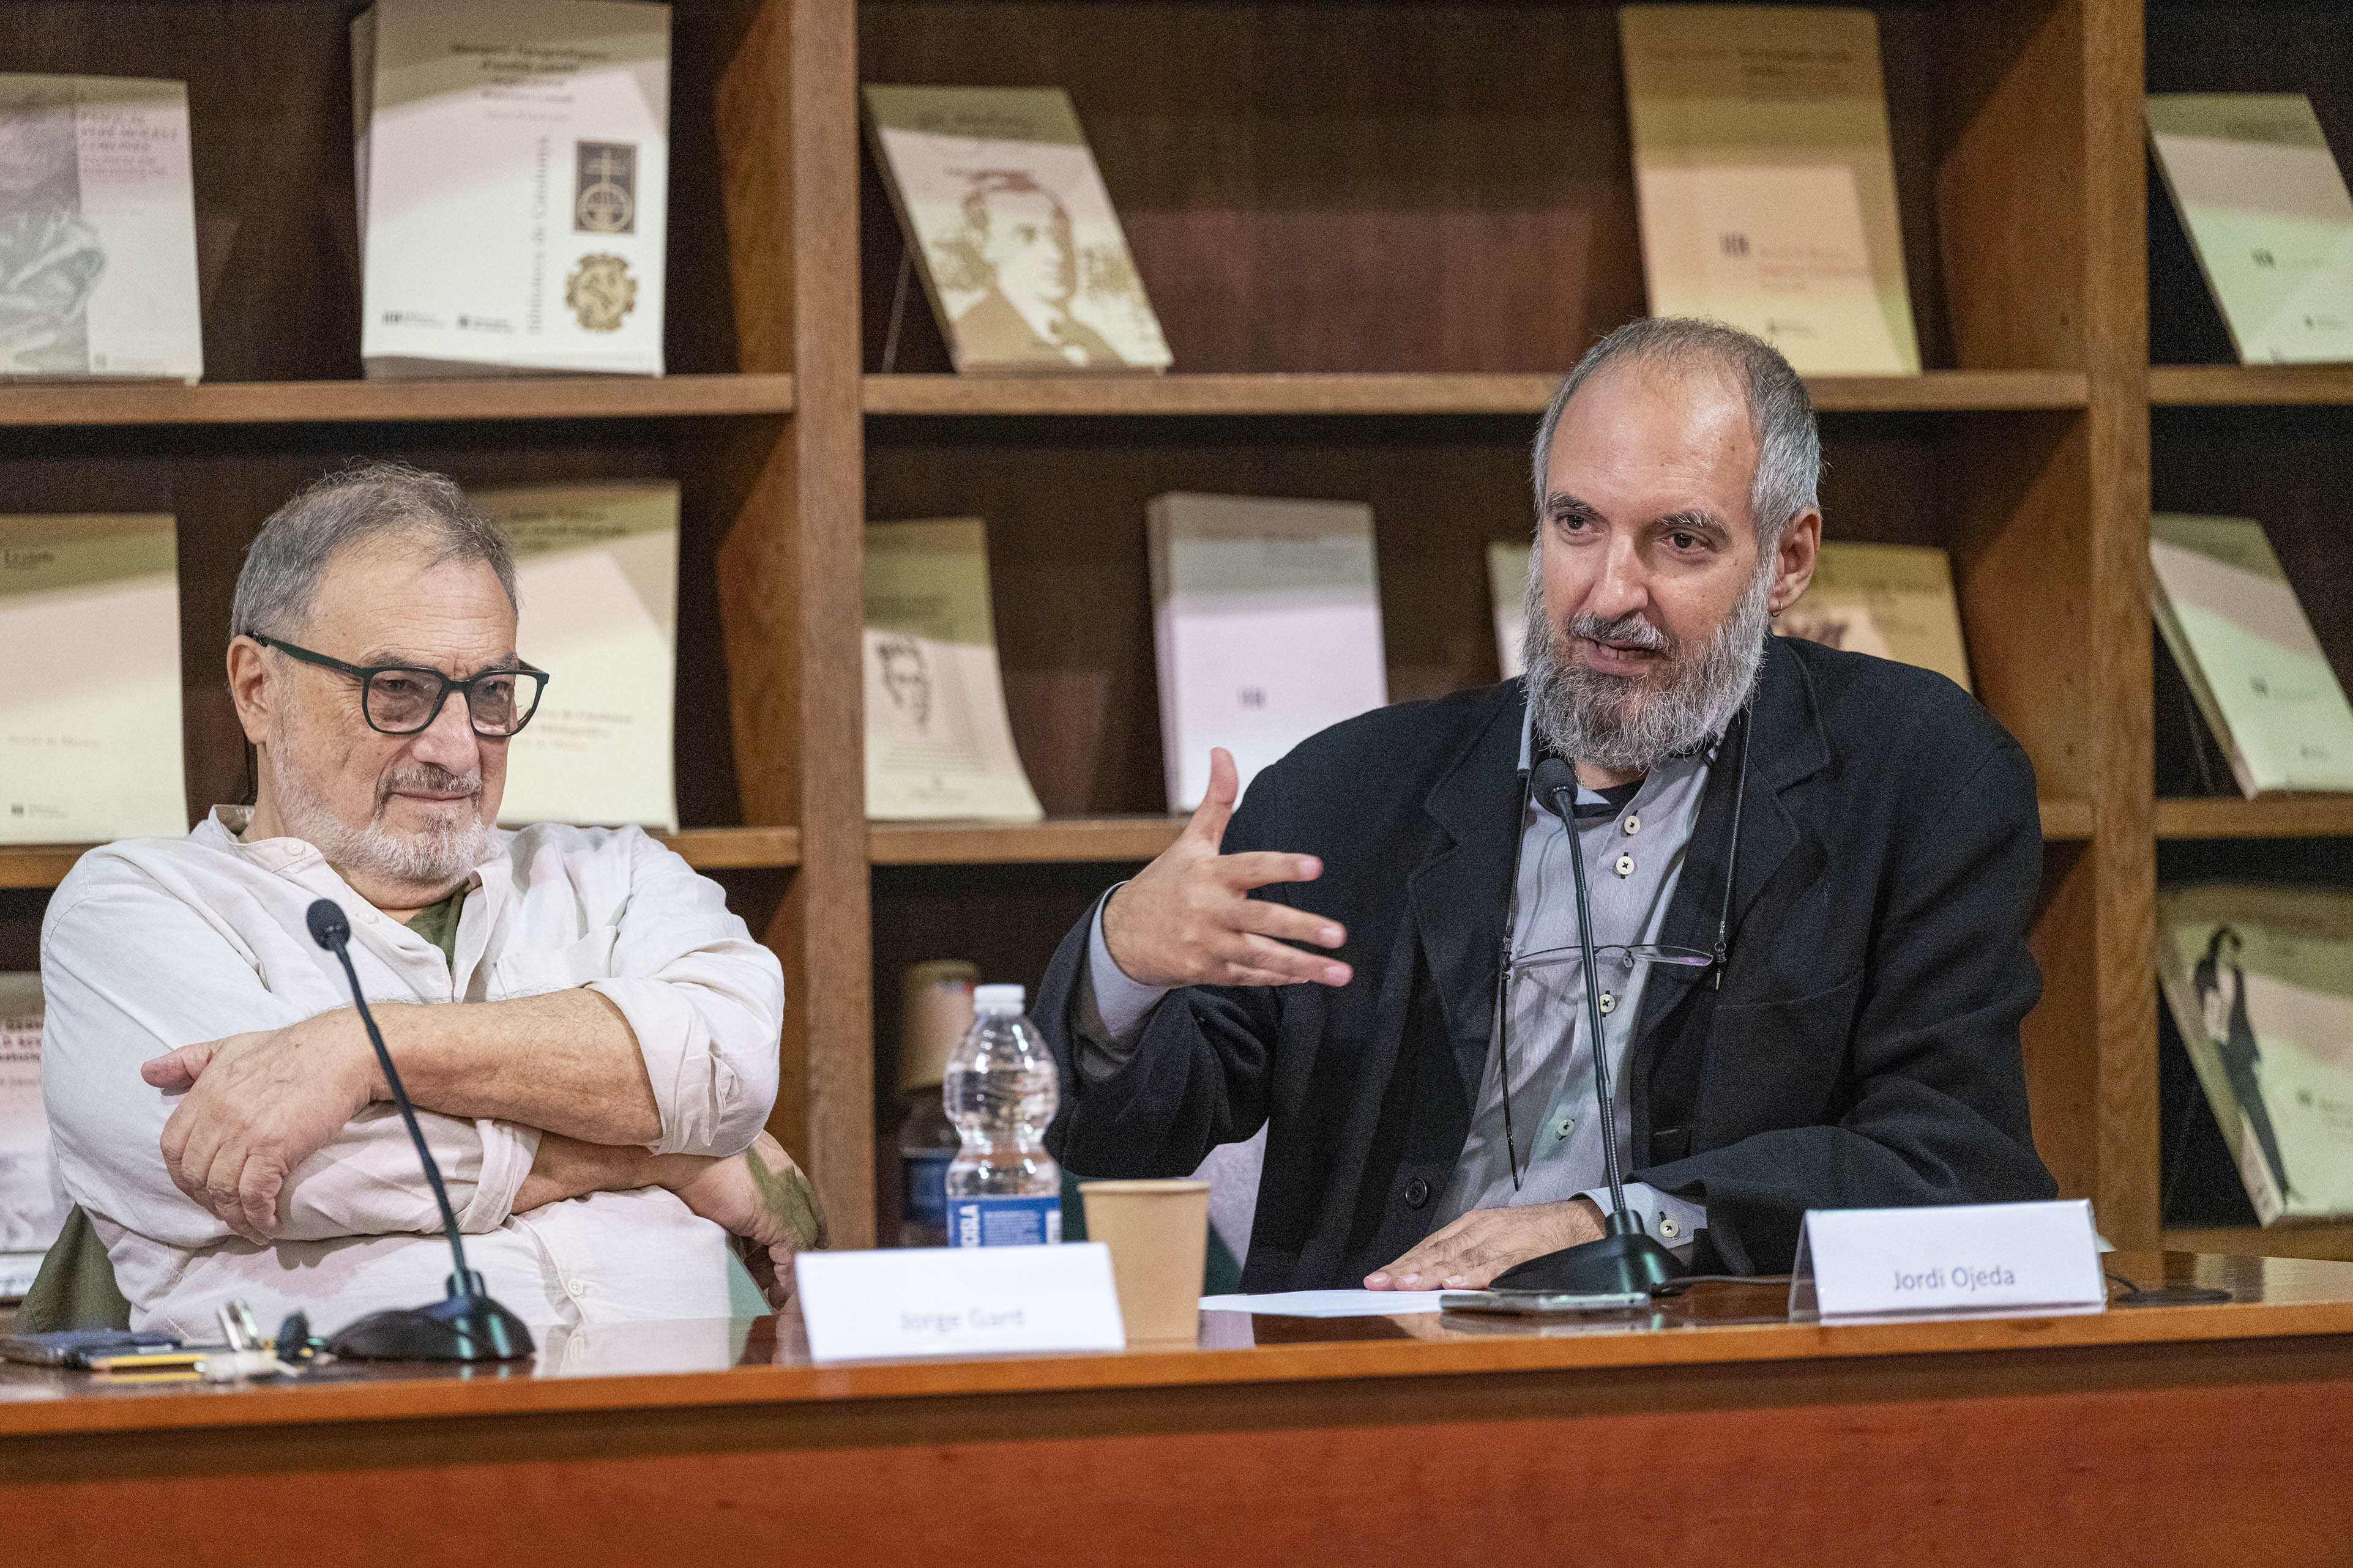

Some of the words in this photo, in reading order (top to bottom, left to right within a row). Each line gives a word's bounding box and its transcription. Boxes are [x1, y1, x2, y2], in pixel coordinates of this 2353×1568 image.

[1894, 1268, 1945, 1291] Jordi
[1951, 1265, 2015, 1291] Ojeda
[900, 1312, 960, 1334] Jorge
